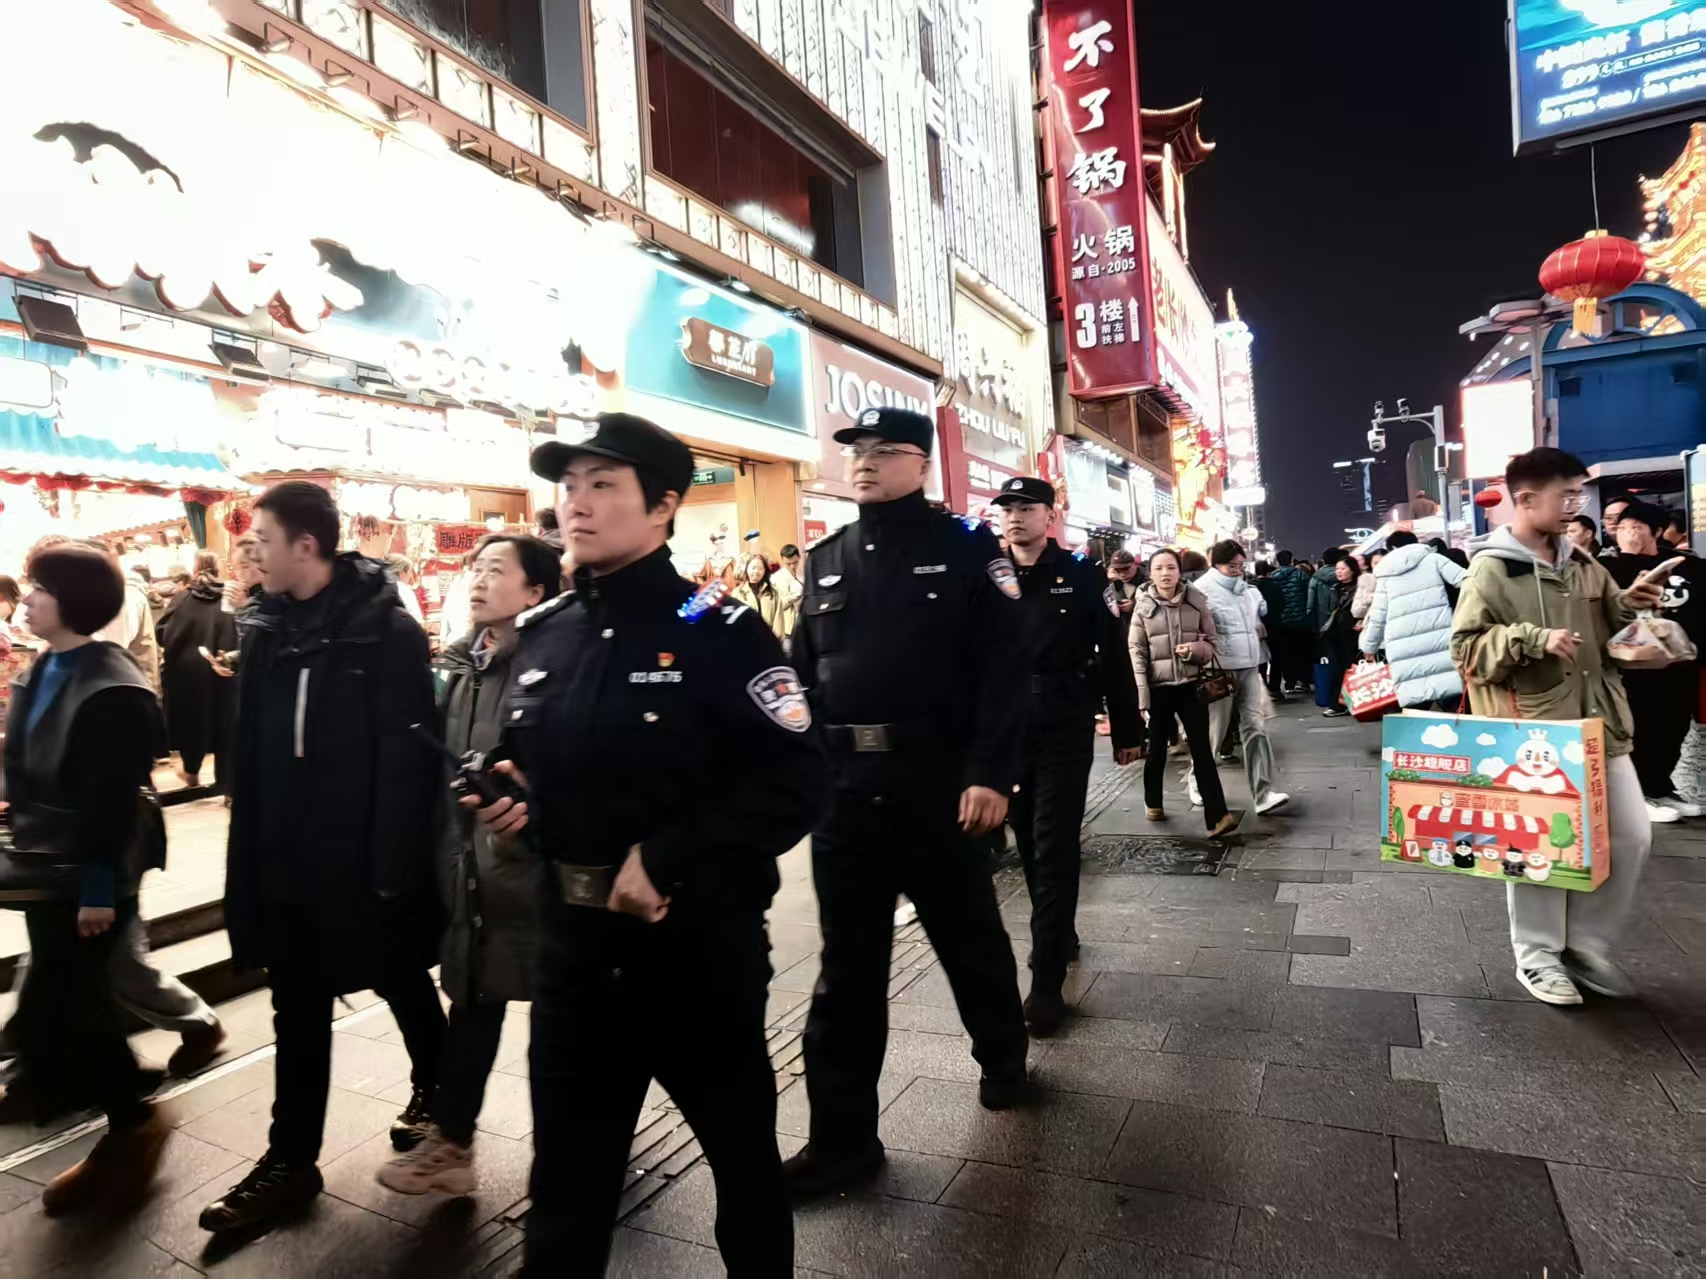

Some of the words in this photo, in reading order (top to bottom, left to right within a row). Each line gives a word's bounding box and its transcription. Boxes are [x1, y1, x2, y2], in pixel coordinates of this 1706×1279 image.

[1064, 20, 1127, 195] 不了锅
[1071, 224, 1135, 263] 火锅
[954, 401, 991, 434] ZHOU
